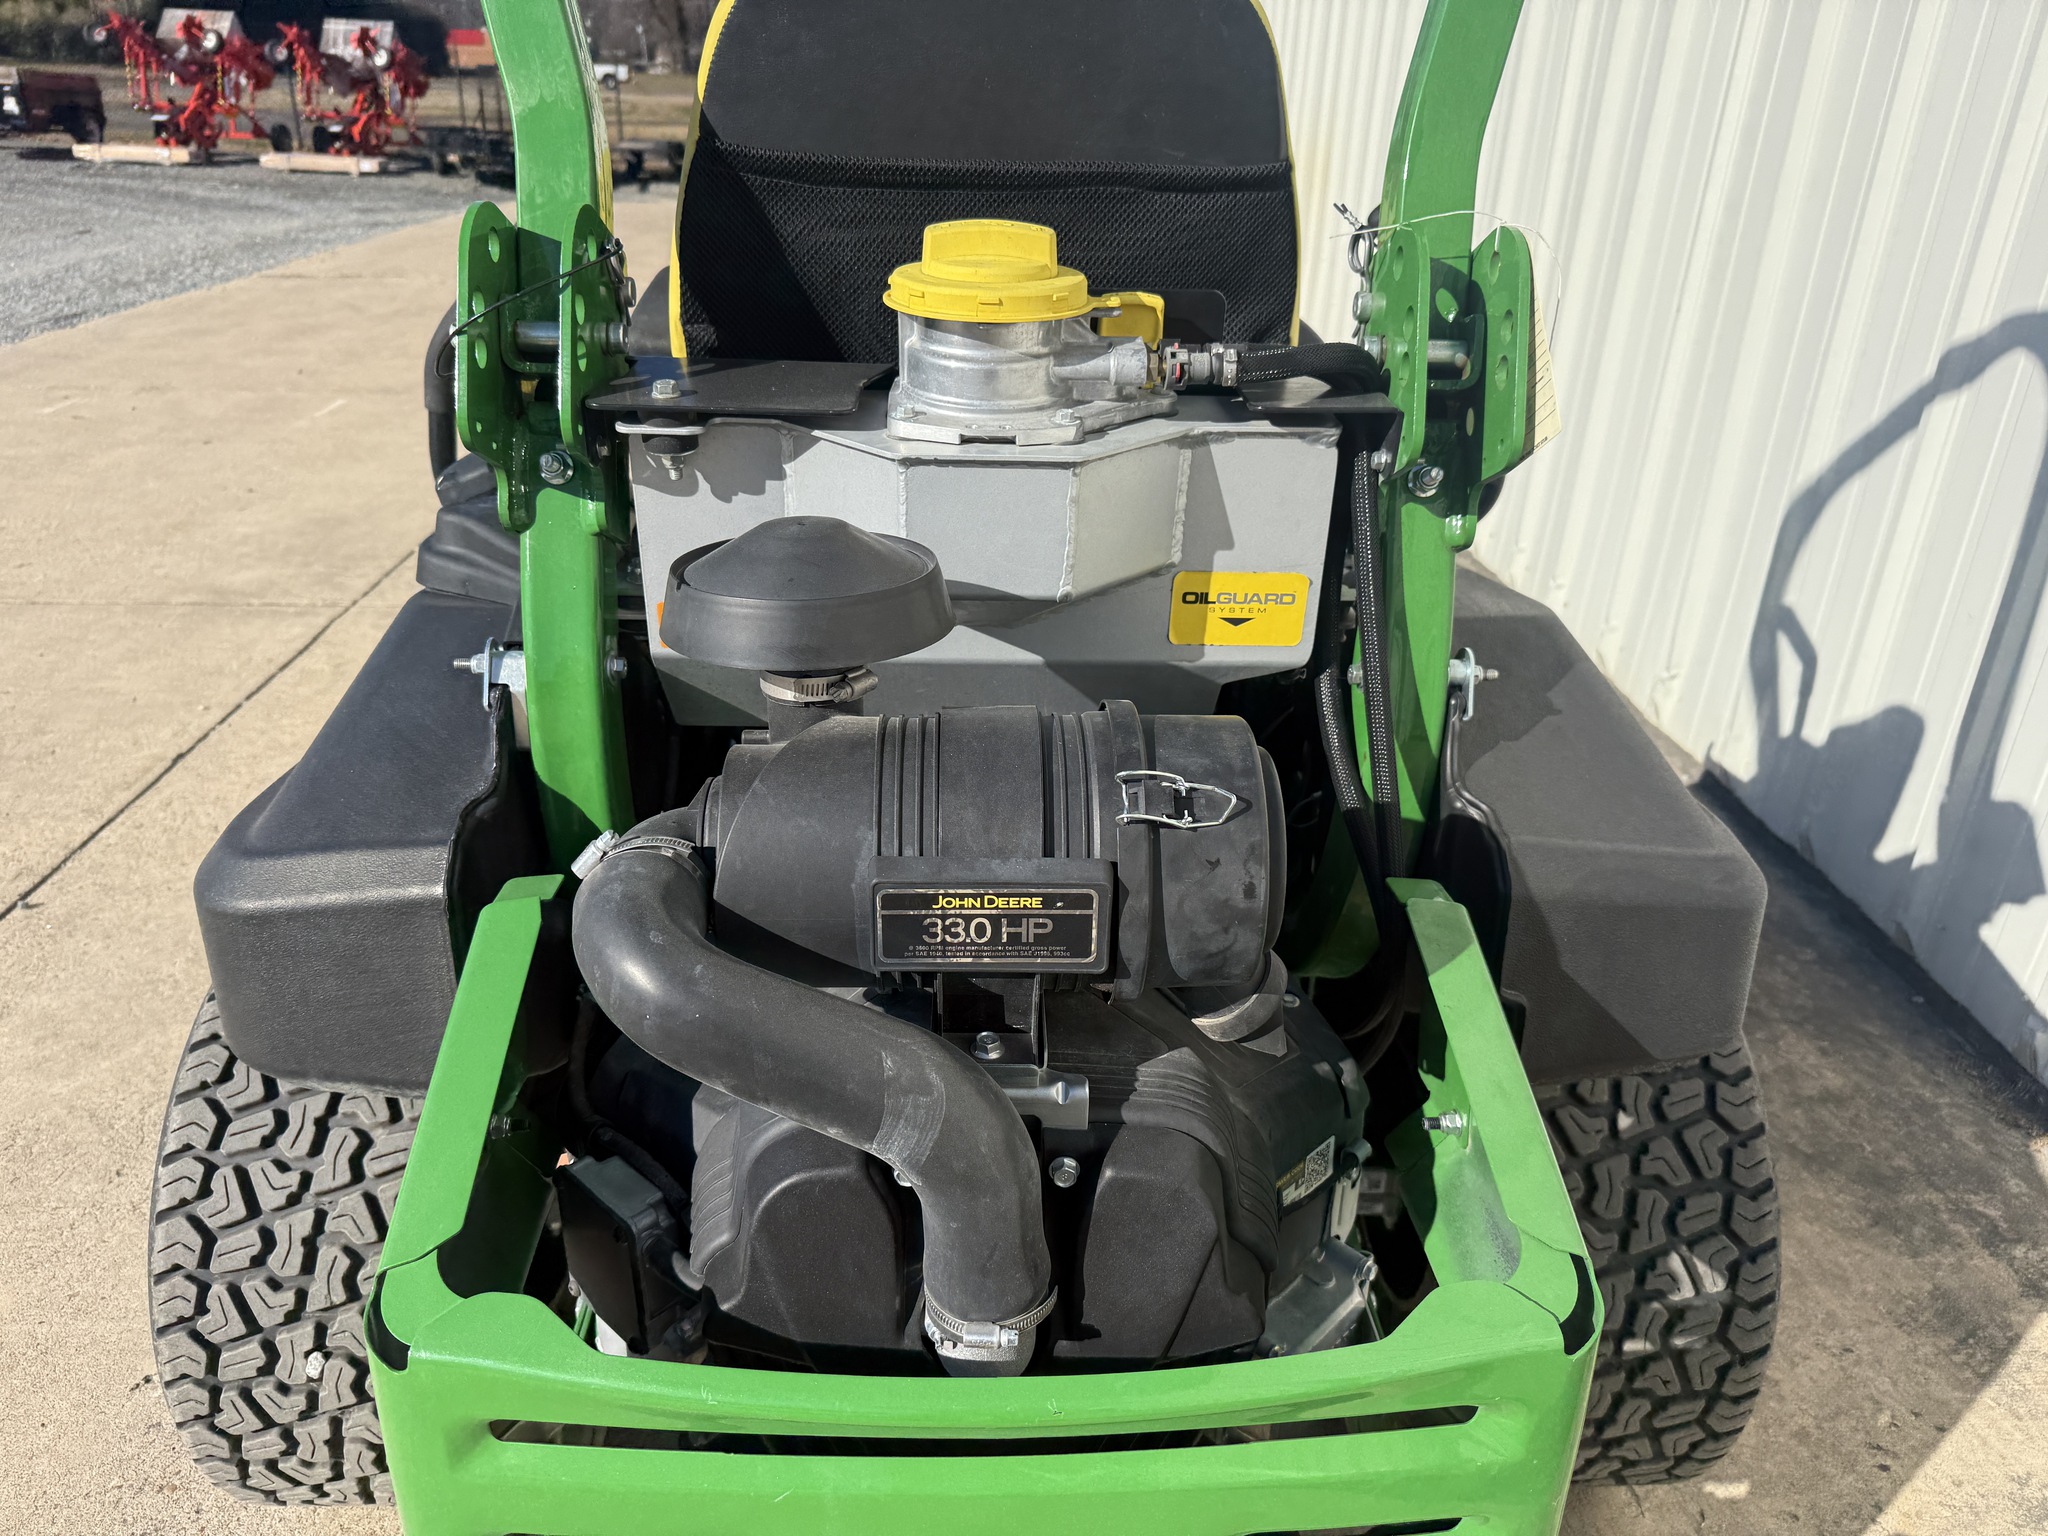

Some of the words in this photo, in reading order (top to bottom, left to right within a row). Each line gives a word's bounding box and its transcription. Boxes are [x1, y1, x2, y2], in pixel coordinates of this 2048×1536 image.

[1181, 591, 1296, 606] OILGUARD
[932, 895, 981, 909] JOHN
[983, 895, 1043, 909] DEERE
[921, 917, 992, 944] 33.0
[1001, 917, 1054, 943] HP
